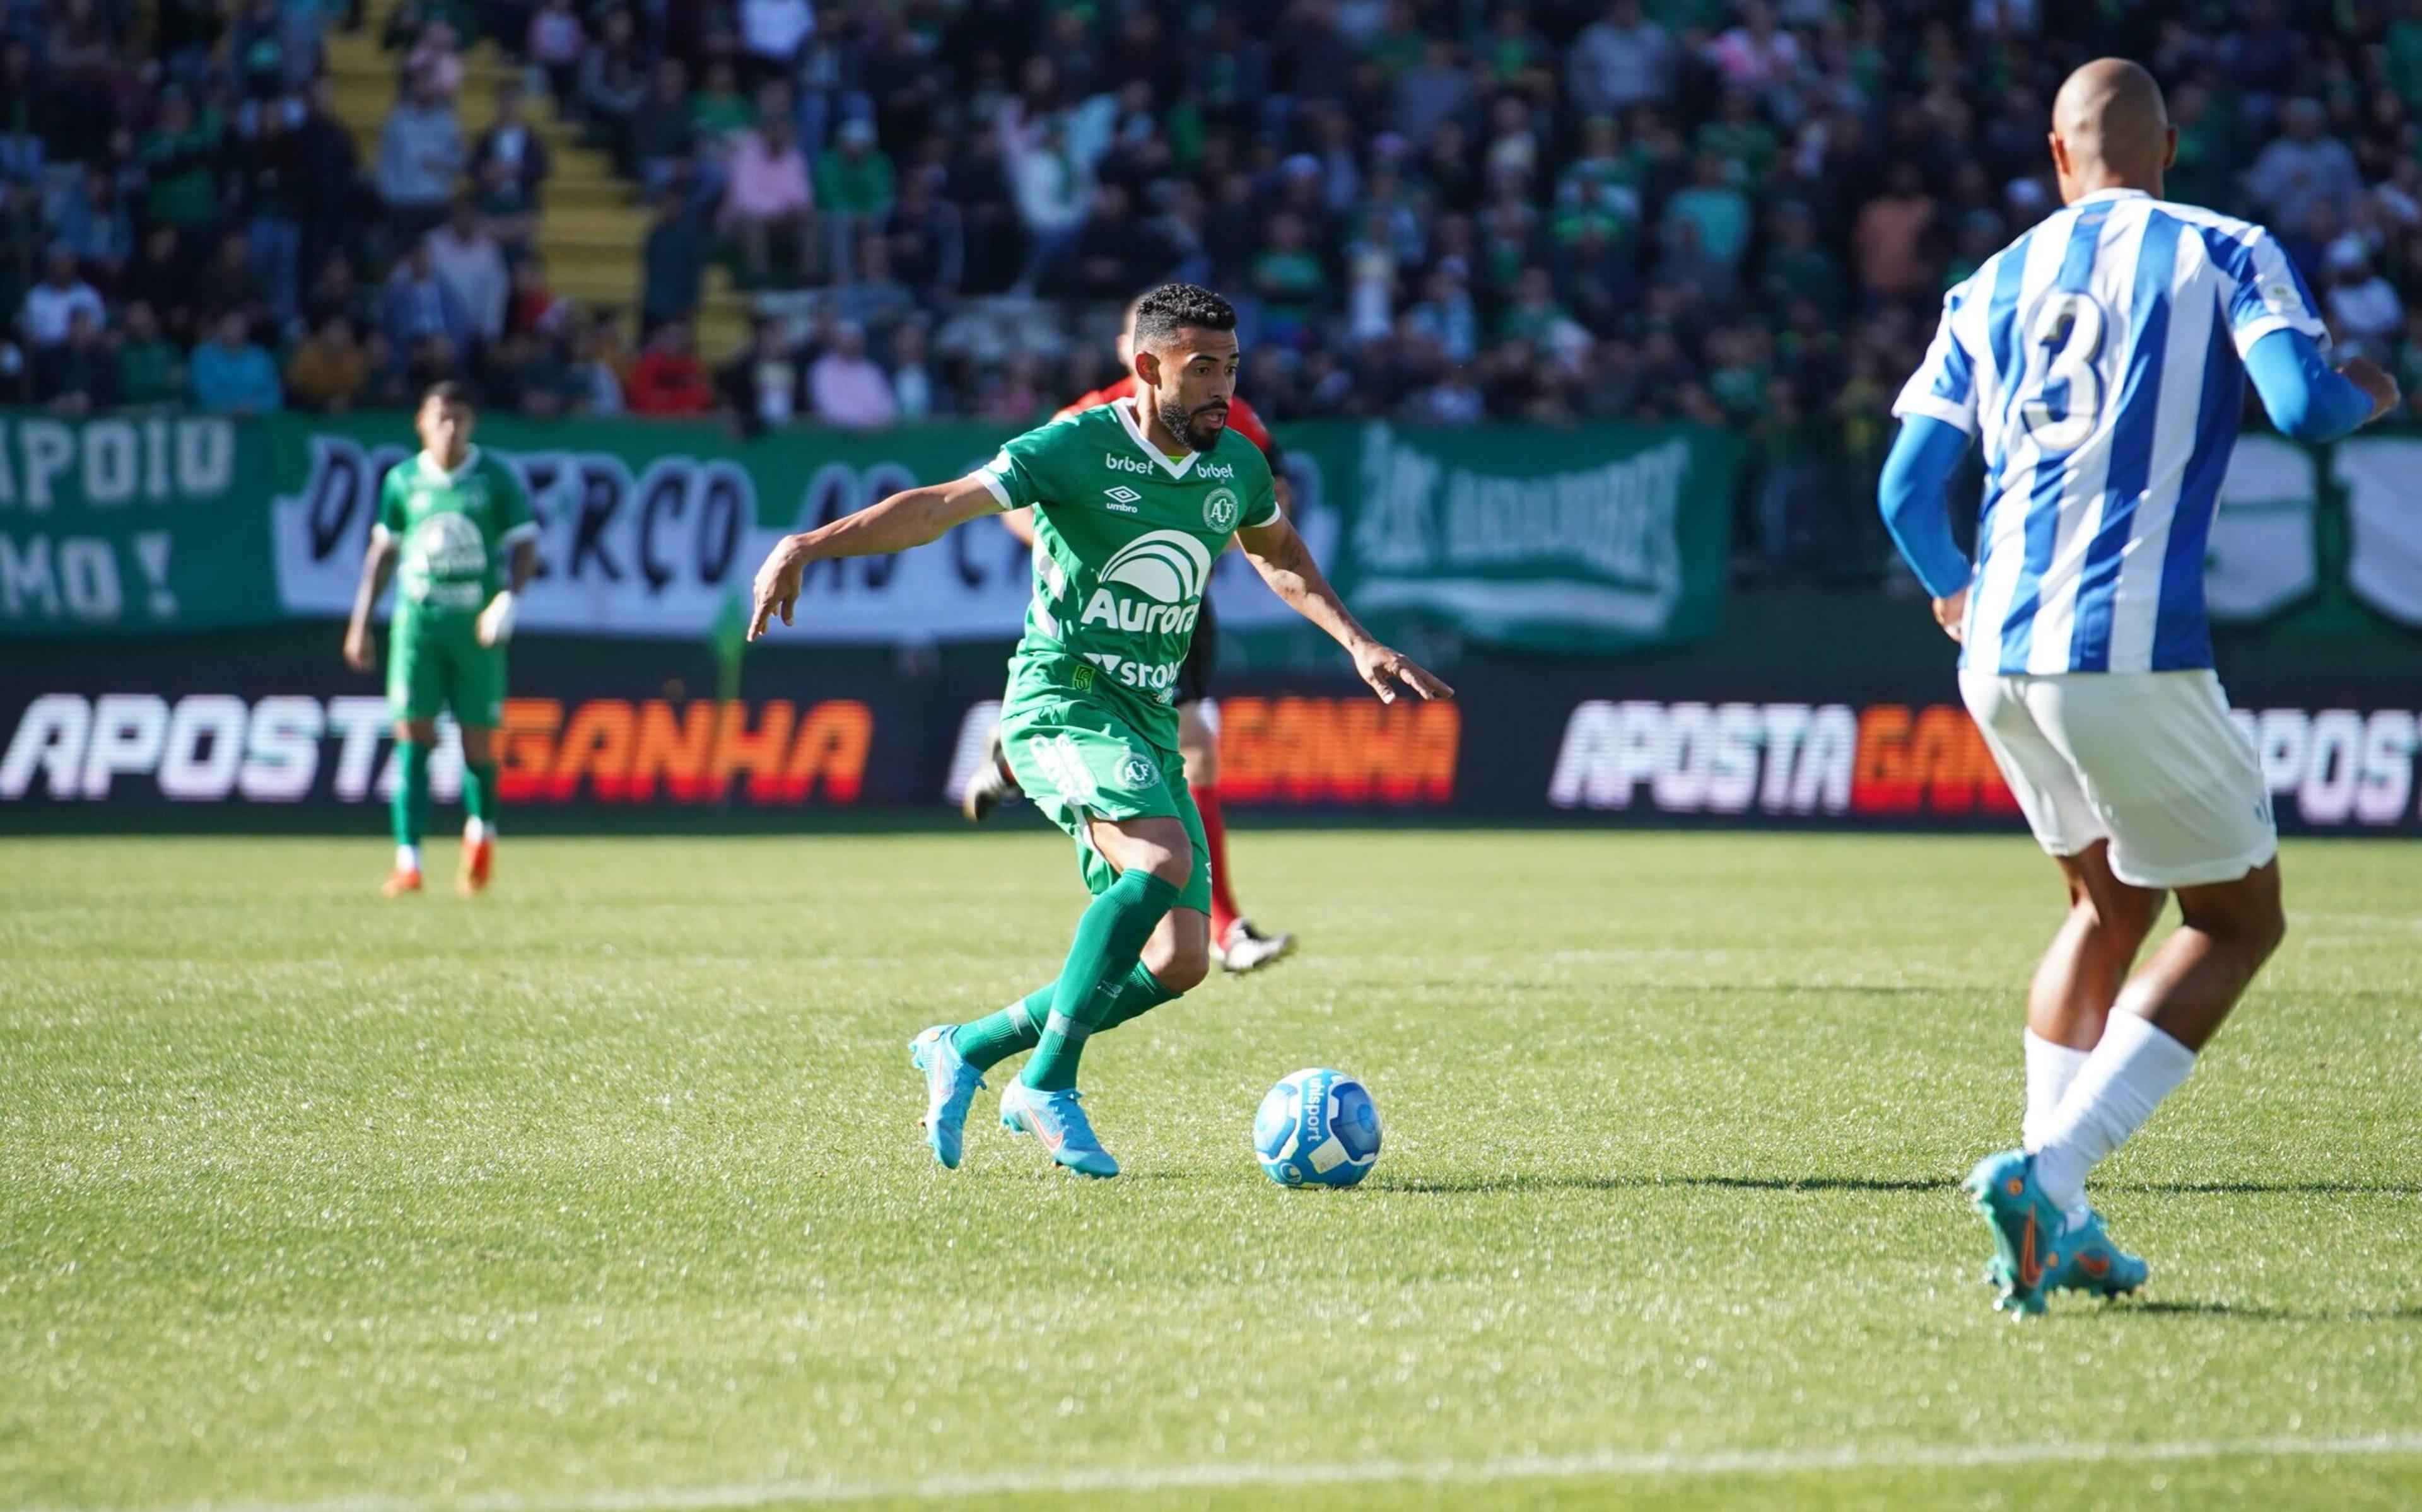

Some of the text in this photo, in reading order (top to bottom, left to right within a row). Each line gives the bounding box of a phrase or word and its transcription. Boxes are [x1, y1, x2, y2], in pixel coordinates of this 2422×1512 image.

[2021, 290, 2110, 451] 3
[1106, 453, 1154, 475] brbet
[1196, 463, 1234, 478] brbet
[1106, 503, 1138, 513] umbro
[1080, 588, 1200, 634] Aurora
[489, 697, 872, 802] GANHA
[1220, 697, 1462, 802] GANHA
[1547, 699, 1858, 815] APOSTA
[2230, 707, 2422, 826] POS
[1303, 1078, 1325, 1142] uhlsport
